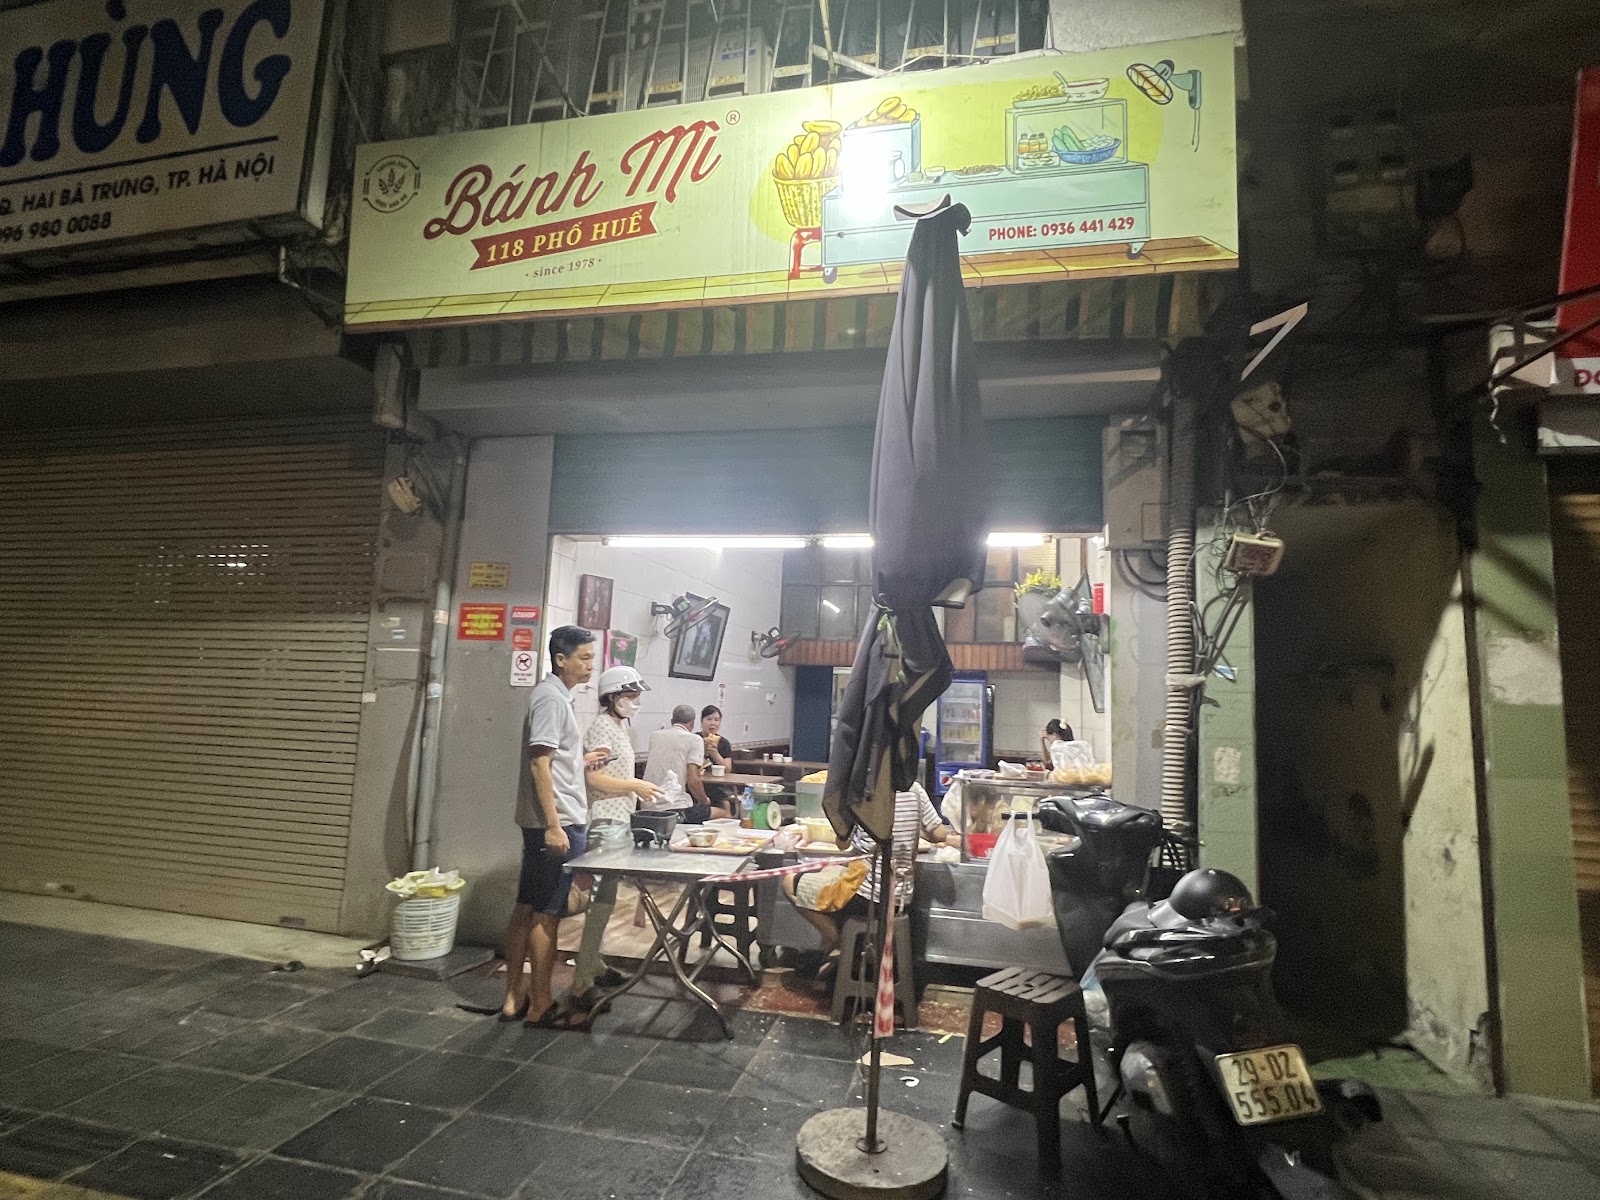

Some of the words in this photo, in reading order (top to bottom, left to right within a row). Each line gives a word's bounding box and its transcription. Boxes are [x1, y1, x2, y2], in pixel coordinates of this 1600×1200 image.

[22, 191, 55, 213] HAI
[167, 169, 191, 189] TP.
[235, 153, 275, 182] NỘI
[423, 150, 603, 240] Bánh
[620, 120, 723, 204] Mì
[487, 238, 525, 263] 118
[532, 221, 583, 254] PHỐ
[590, 208, 643, 242] HUẾ
[988, 225, 1037, 241] PHONE:
[1041, 222, 1076, 237] 0936
[1079, 219, 1104, 234] 441
[1107, 216, 1135, 231] 429
[533, 265, 565, 278] since
[568, 257, 595, 272] 1978
[1235, 1081, 1317, 1120] 555.04
